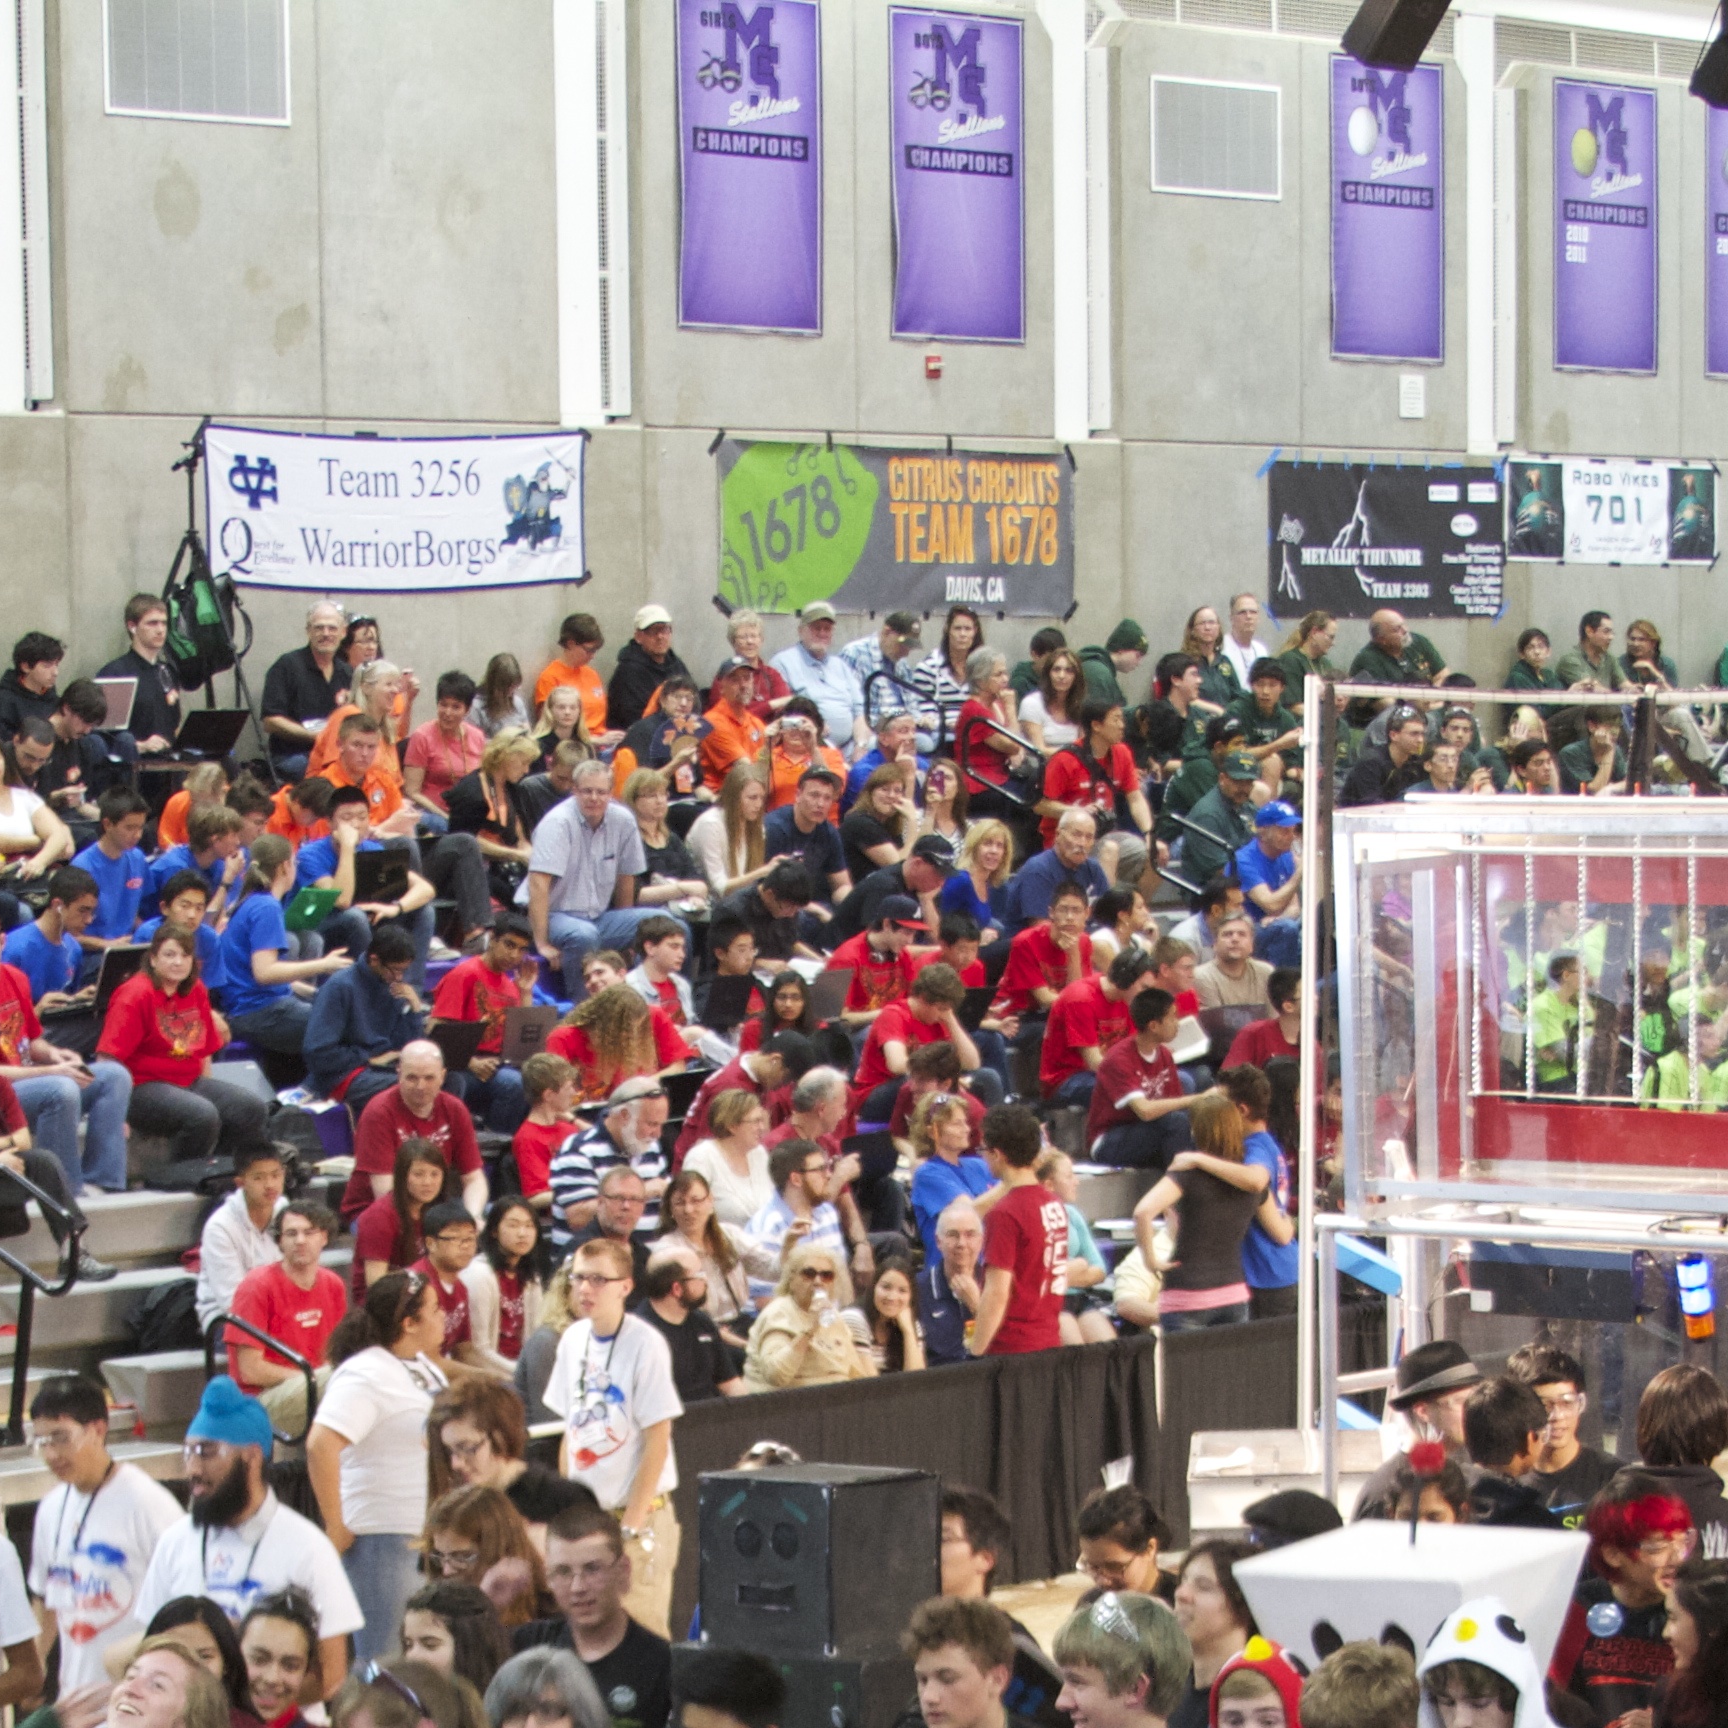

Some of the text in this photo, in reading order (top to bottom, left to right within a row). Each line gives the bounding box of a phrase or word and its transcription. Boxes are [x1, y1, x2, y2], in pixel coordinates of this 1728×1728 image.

[696, 130, 805, 158] CHAMPIONS
[910, 149, 1010, 175] CHAMPIONS
[1344, 184, 1431, 208] CHAMPIONS
[1566, 204, 1645, 226] CHAMPIONS
[1566, 225, 1589, 243] 2010
[1566, 244, 1587, 263] 2011
[319, 457, 481, 499] Team 3256
[888, 456, 1060, 506] CITRUS CIRCUITS
[740, 474, 841, 573] 1678
[1586, 495, 1642, 525] 701
[889, 502, 1059, 566] TEAM 1678
[299, 526, 497, 575] WarriorBorgs
[1301, 549, 1360, 566] METALLIC
[1364, 548, 1423, 567] THUNDER
[945, 575, 1005, 604] DAVIS, CA
[1373, 584, 1400, 598] TEAM
